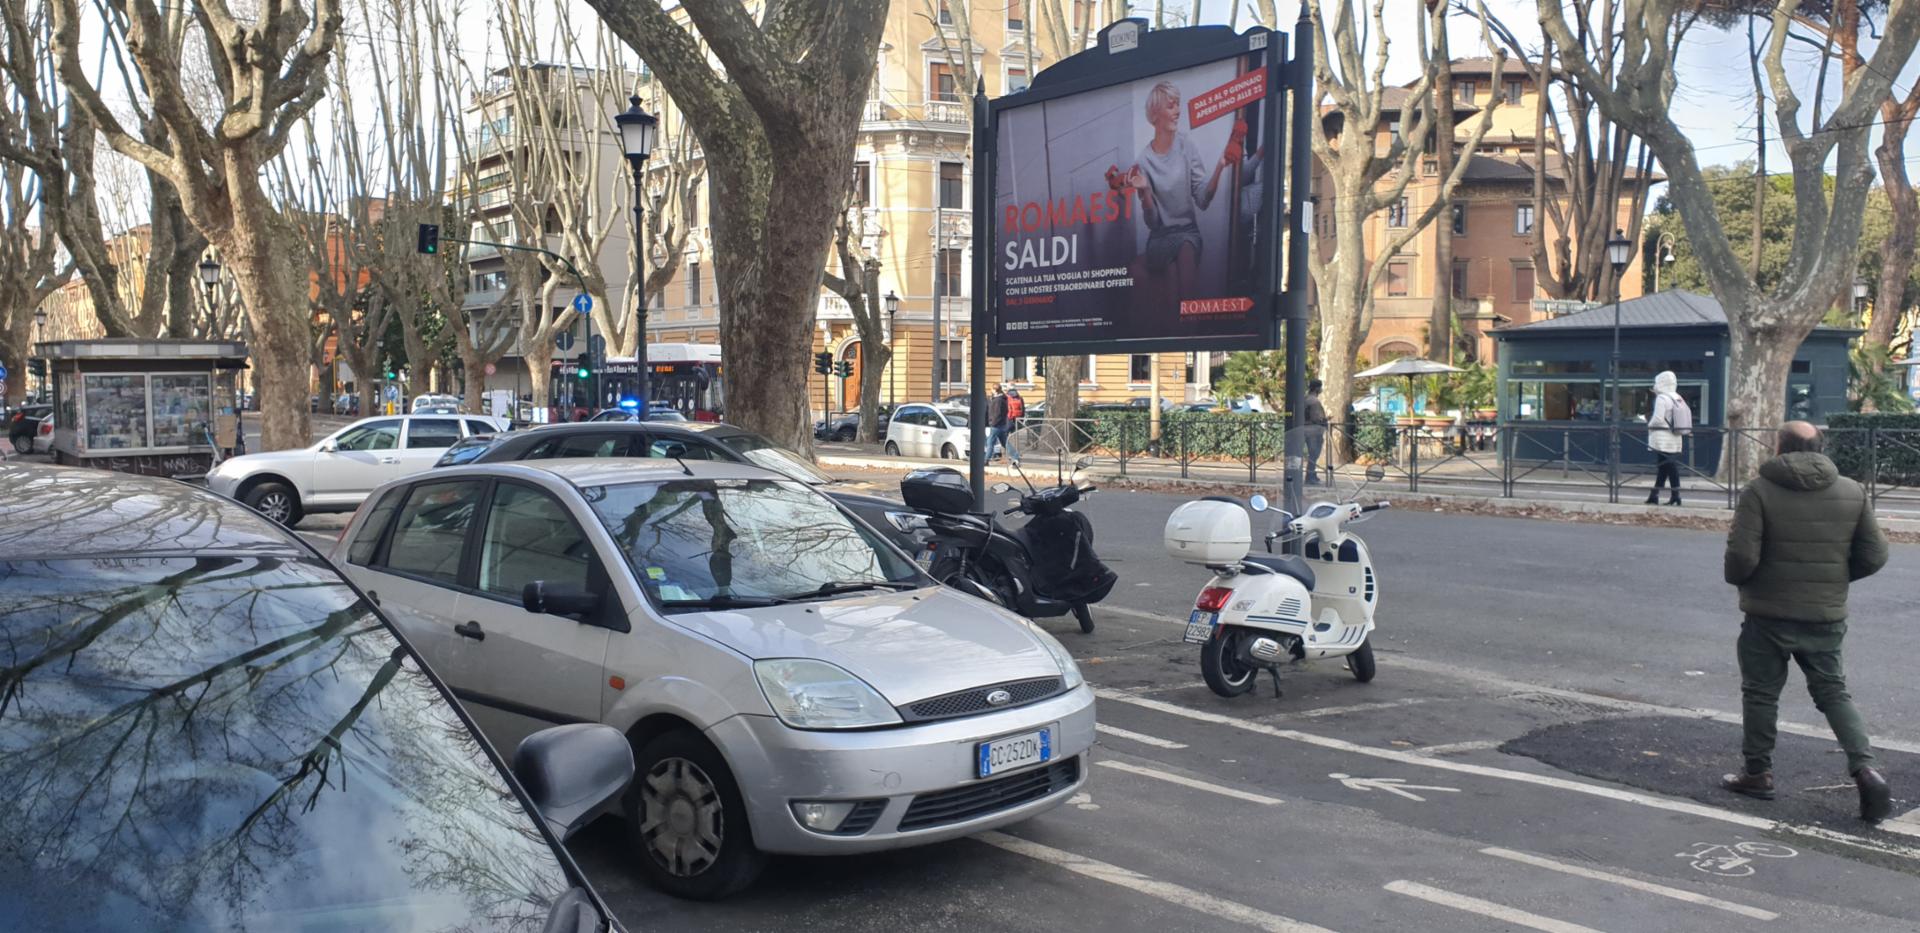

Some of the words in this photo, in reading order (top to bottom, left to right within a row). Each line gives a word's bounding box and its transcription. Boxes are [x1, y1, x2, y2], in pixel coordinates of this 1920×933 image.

[1214, 93, 1222, 101] AL
[1229, 75, 1262, 93] GENNAIO
[1196, 105, 1217, 118] APERTI
[1219, 97, 1235, 109] FINO
[1237, 89, 1251, 101] ALLE
[1004, 187, 1136, 238] ROMAEST
[1004, 234, 1077, 271] SALDI
[1005, 275, 1033, 285] SCATENA
[1034, 274, 1042, 283] LA
[1043, 273, 1055, 282] TUA
[1056, 271, 1082, 281] VOGLIA
[1083, 270, 1090, 278] DI
[1091, 267, 1127, 278] SHOPPING
[1005, 287, 1020, 296] CON
[1021, 286, 1028, 295] LE
[1028, 284, 1052, 294] NOSTRE
[1053, 280, 1105, 292] STRAORDINARIE
[1106, 278, 1134, 288] OFFERTE
[1180, 297, 1247, 314] ROMAEST
